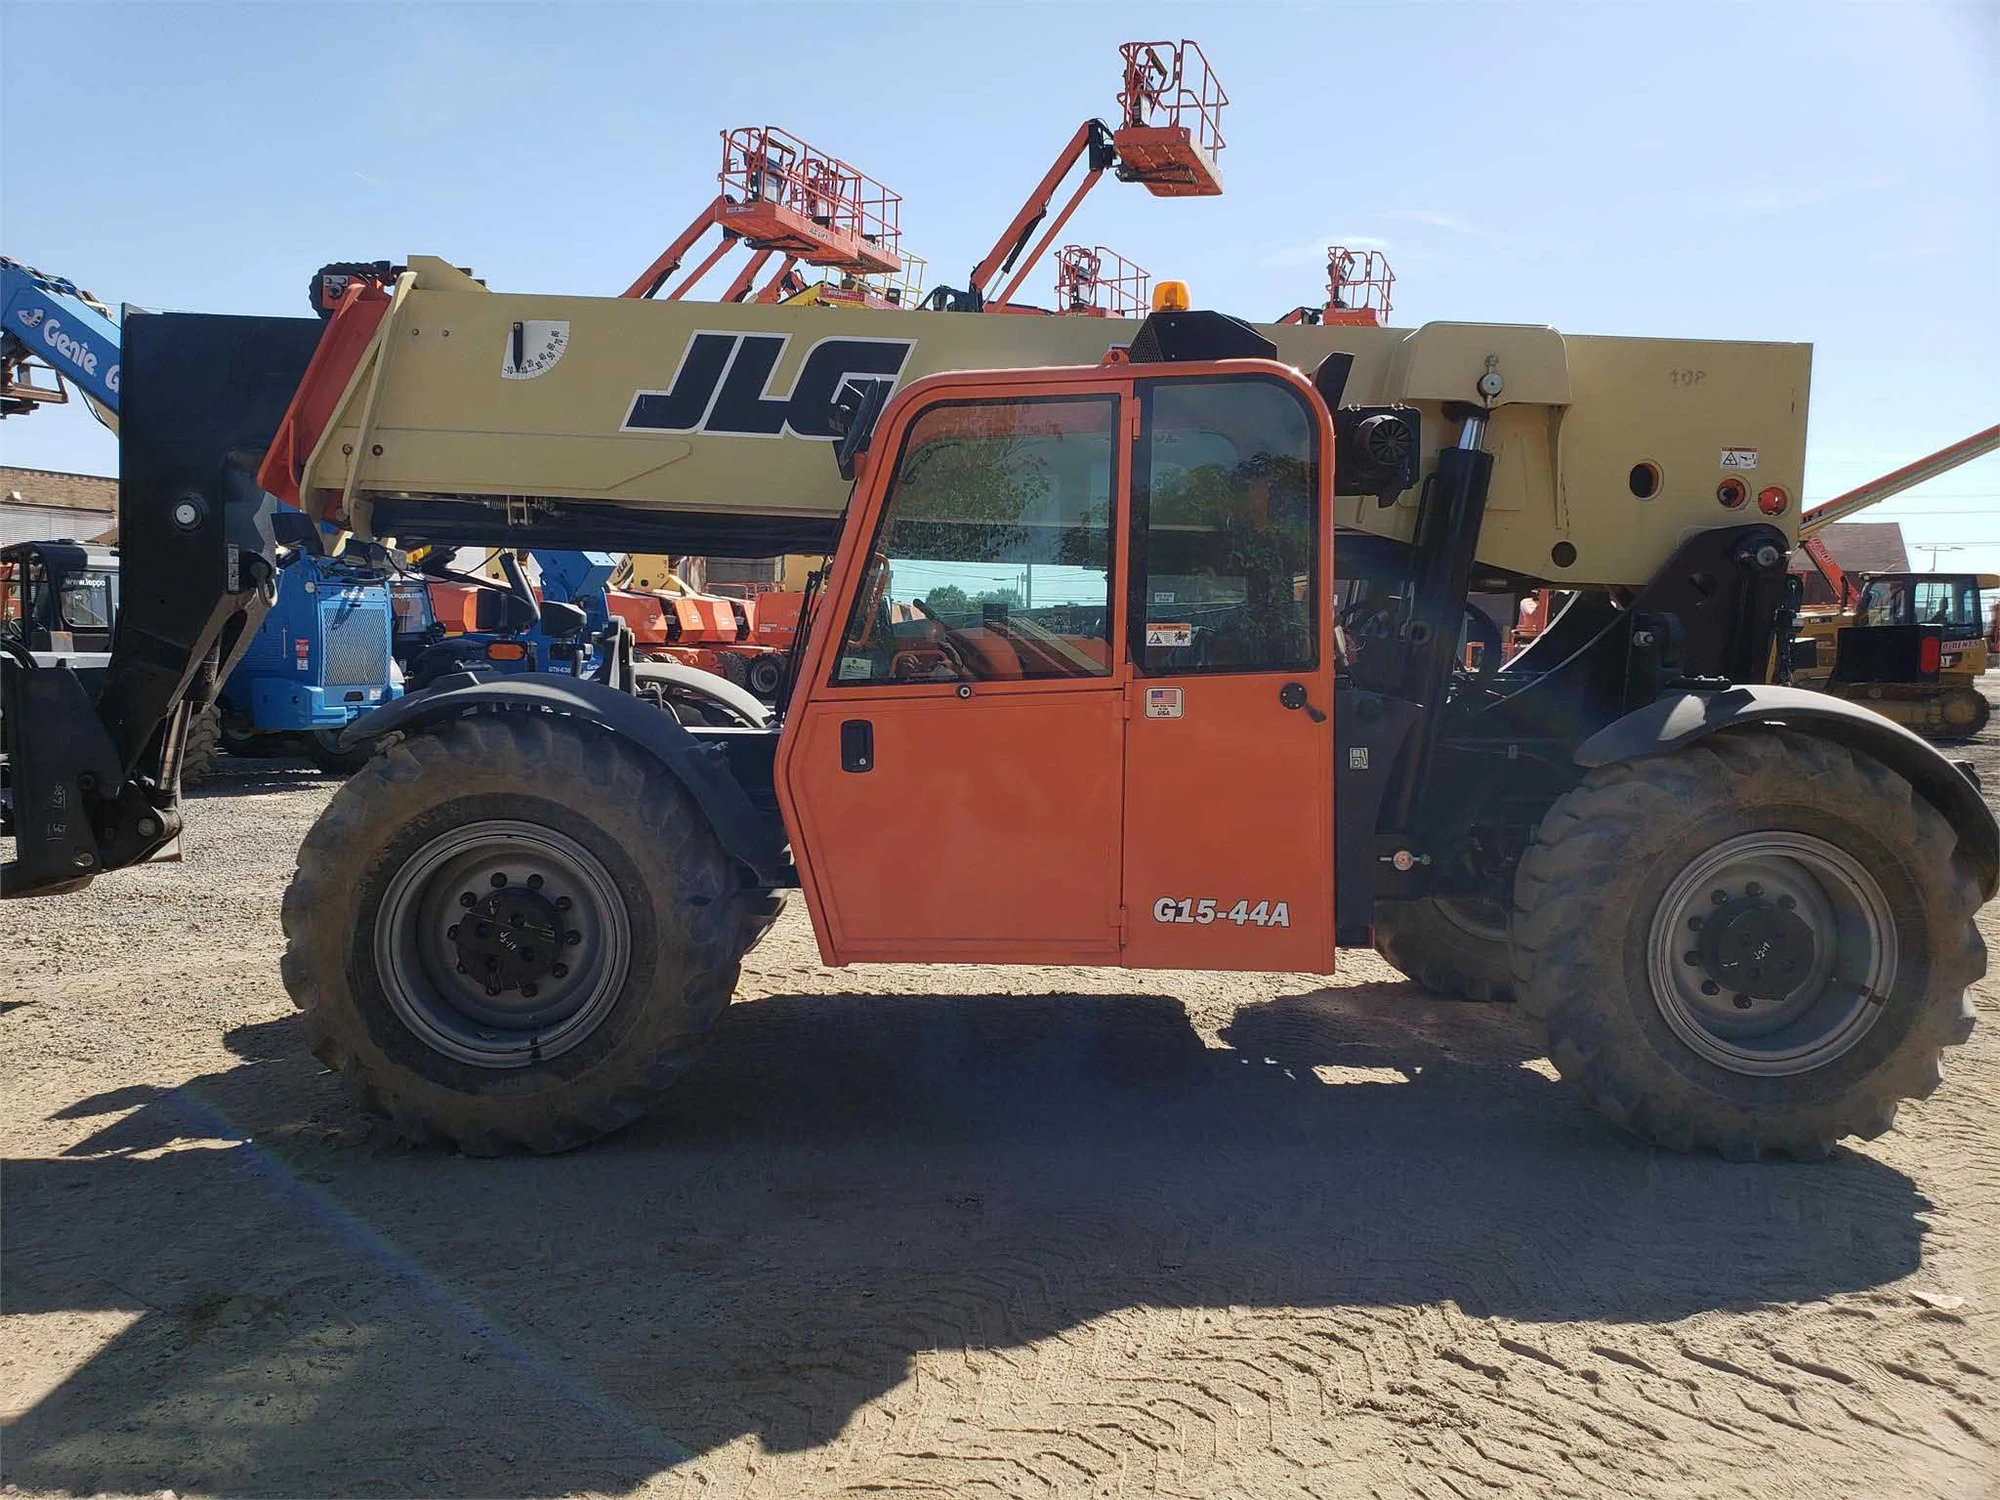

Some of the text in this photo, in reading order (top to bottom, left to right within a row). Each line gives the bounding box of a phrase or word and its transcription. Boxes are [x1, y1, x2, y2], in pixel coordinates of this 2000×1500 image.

[43, 318, 98, 376] Genie
[619, 328, 918, 440] JLG
[1153, 896, 1290, 927] G15-44A
